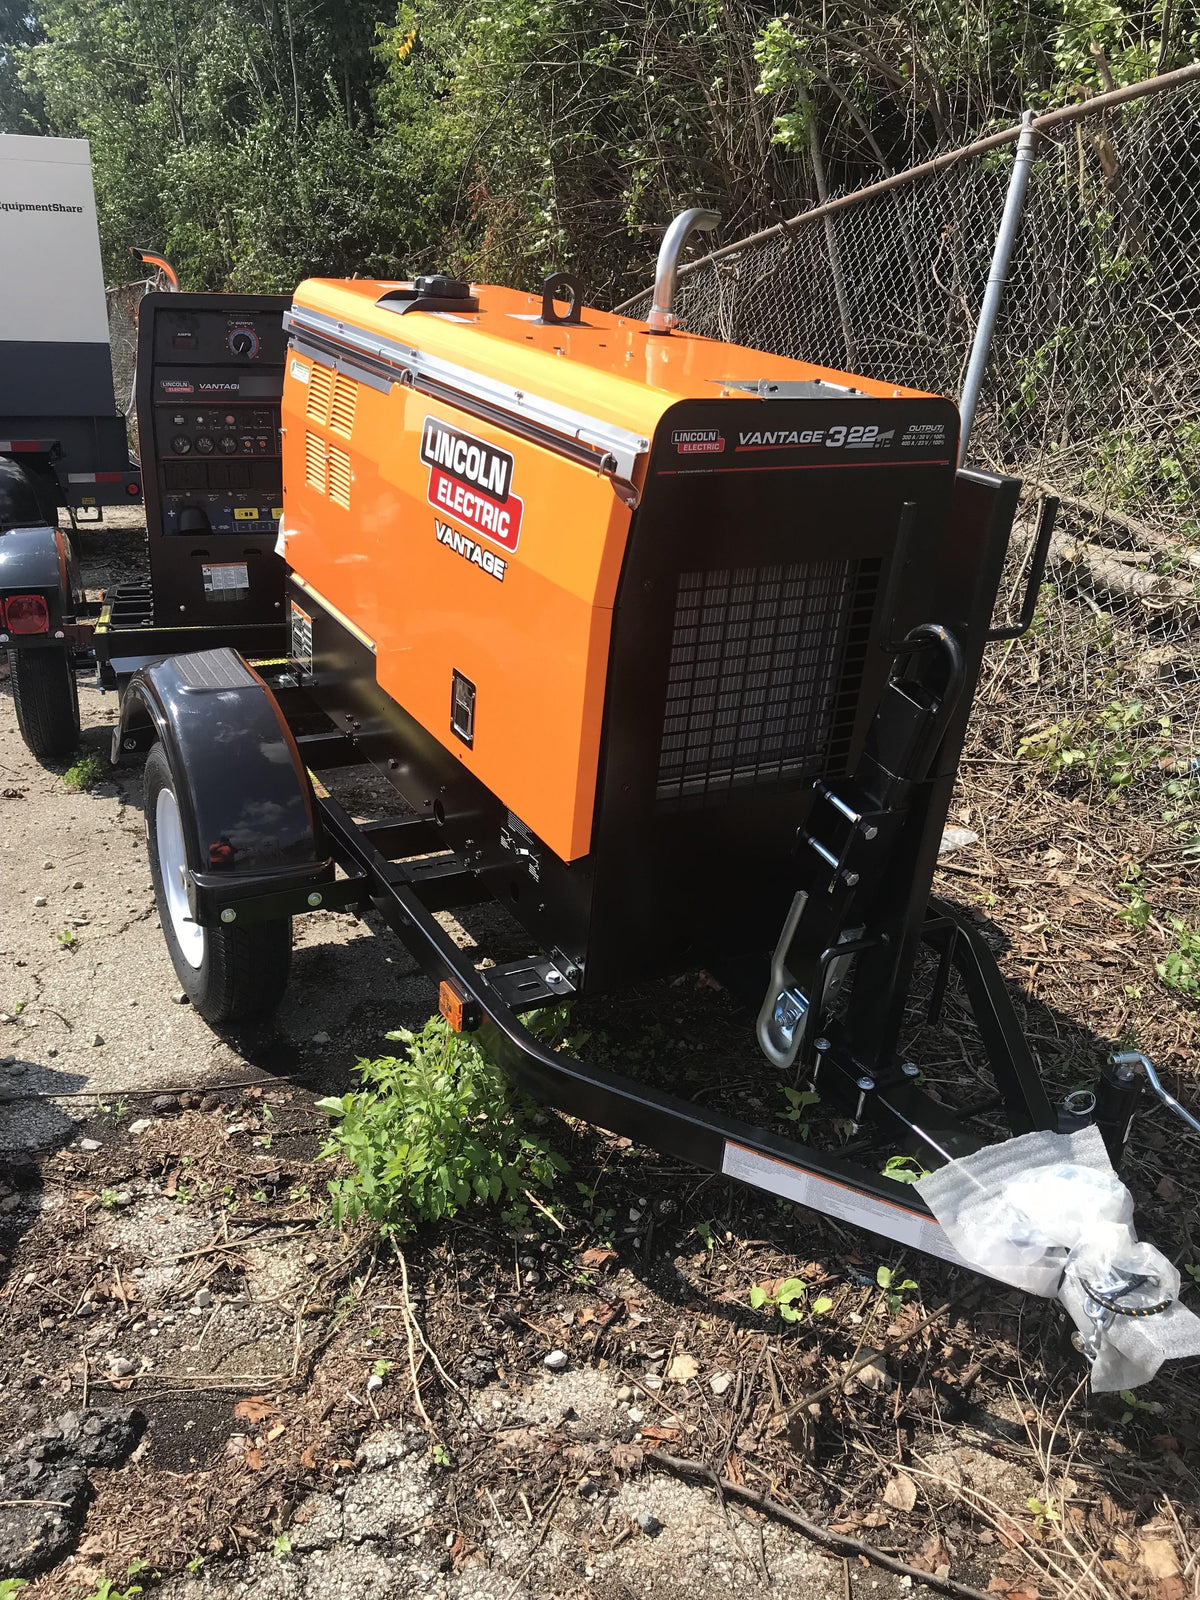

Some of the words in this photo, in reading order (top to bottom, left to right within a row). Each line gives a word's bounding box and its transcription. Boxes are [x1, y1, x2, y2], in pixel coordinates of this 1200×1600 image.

[674, 431, 717, 442] LINCOLN
[683, 443, 720, 452] ELECTRIC
[738, 430, 824, 445] VANTAGE
[825, 425, 879, 448] 322
[424, 425, 508, 496] LINCOLN
[436, 476, 511, 538] ELECTRIC
[435, 518, 507, 582] VANTAGE
